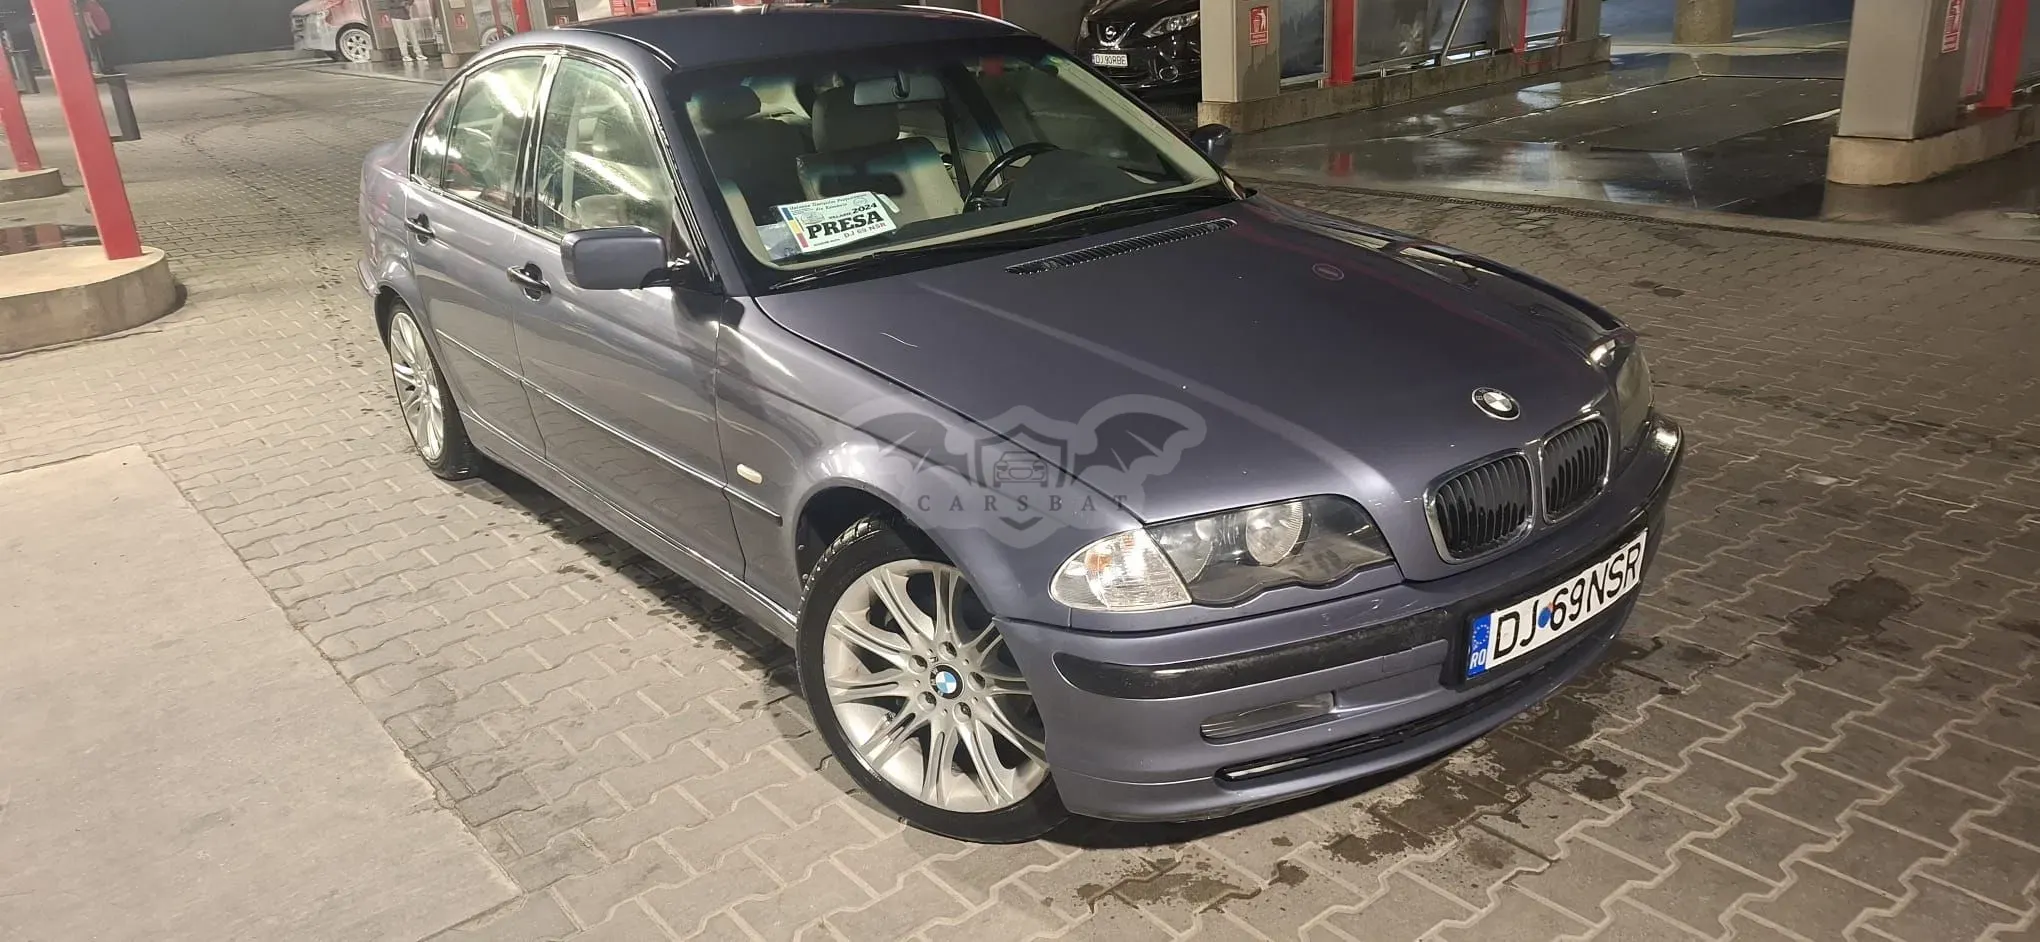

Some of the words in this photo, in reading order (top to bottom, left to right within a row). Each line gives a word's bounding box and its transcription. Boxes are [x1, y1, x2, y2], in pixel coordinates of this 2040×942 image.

[851, 203, 878, 214] 2024
[806, 210, 884, 239] PRESA
[843, 231, 856, 239] DJ
[1470, 648, 1487, 670] RO
